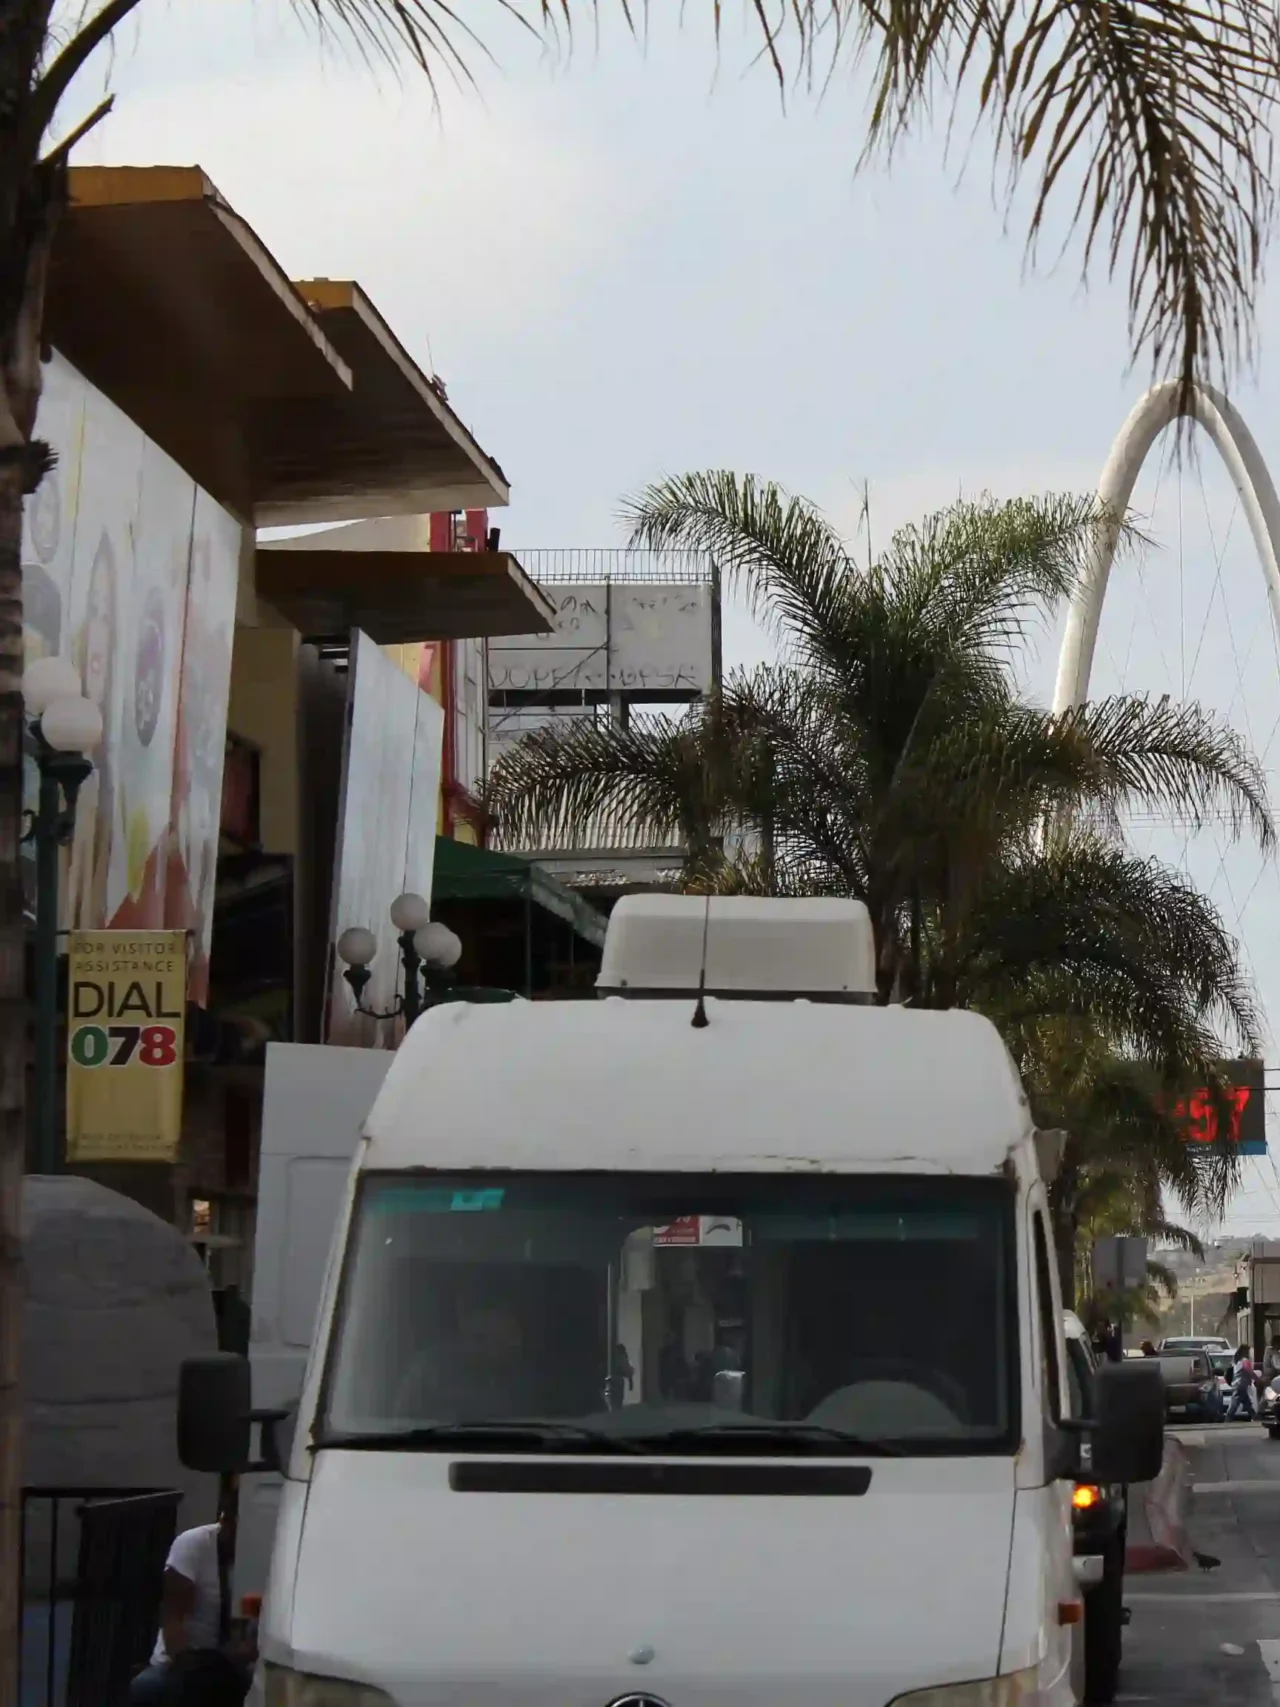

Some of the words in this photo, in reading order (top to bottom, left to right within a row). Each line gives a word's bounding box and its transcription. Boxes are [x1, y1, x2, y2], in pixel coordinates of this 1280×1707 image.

[75, 943, 104, 954] FOR
[112, 943, 176, 954] VISITOR
[75, 961, 174, 972] ASSISTANCE
[73, 981, 181, 1018] DIAL
[71, 1025, 176, 1066] 078
